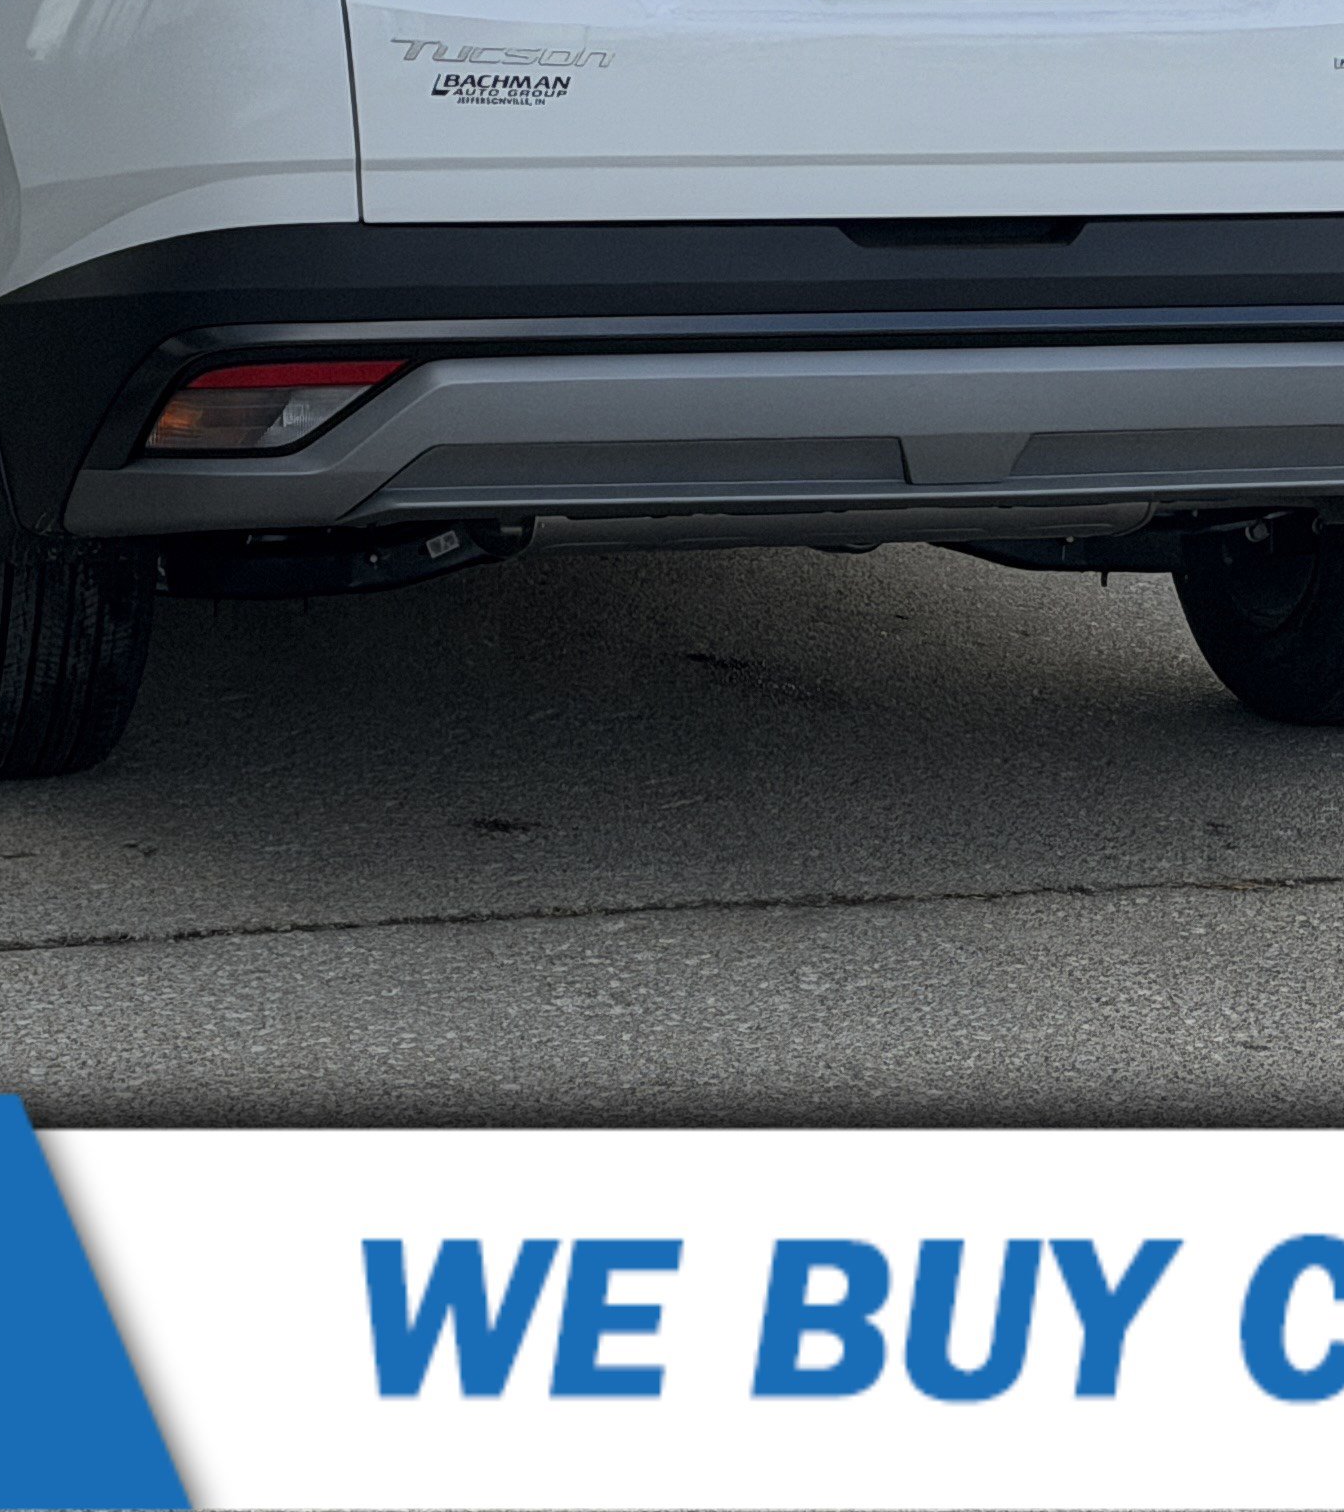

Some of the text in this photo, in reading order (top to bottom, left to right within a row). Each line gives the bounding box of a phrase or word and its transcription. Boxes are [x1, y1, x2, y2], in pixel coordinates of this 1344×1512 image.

[443, 74, 572, 89] BACHMAN
[453, 88, 568, 98] AUTO GROUP
